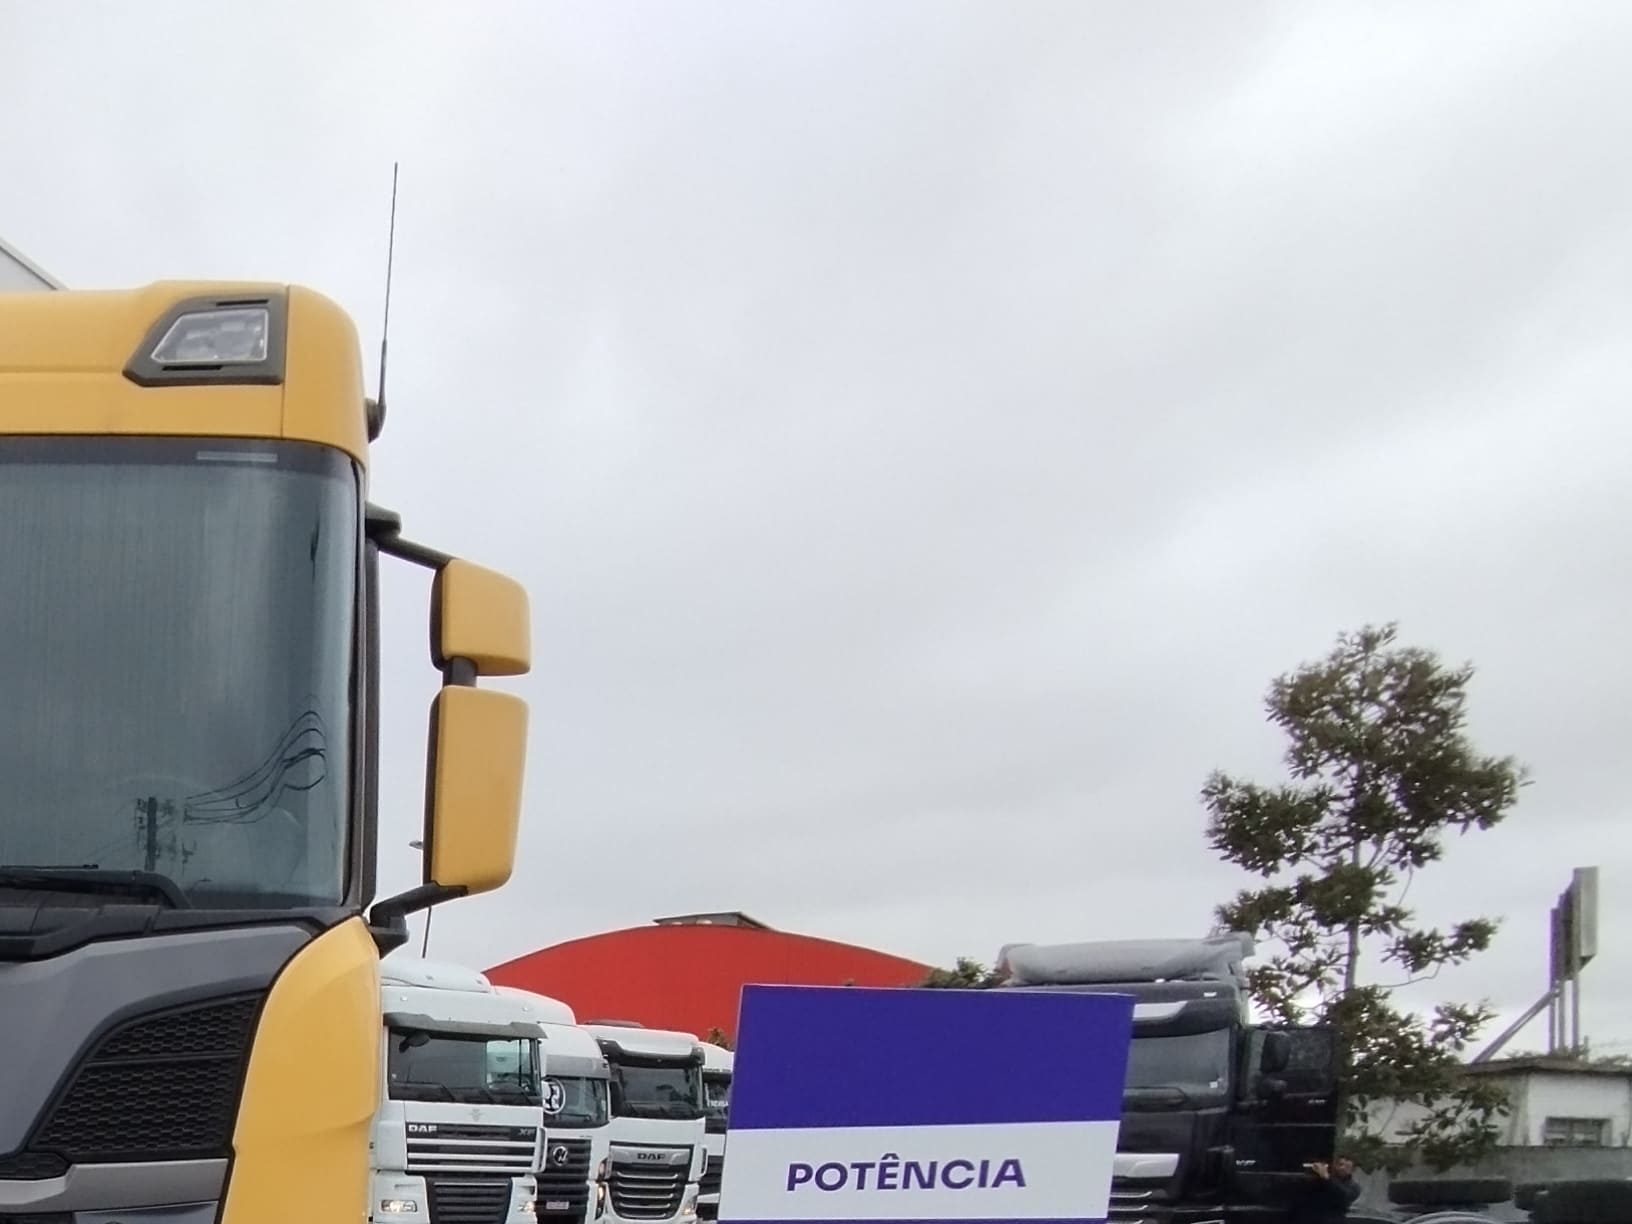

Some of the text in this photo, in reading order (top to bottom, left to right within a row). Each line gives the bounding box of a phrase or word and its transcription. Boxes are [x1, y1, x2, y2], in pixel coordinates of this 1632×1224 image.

[408, 1124, 438, 1133] DAF
[637, 1152, 666, 1161] DAF
[786, 1153, 1027, 1191] POTÊNCIA
